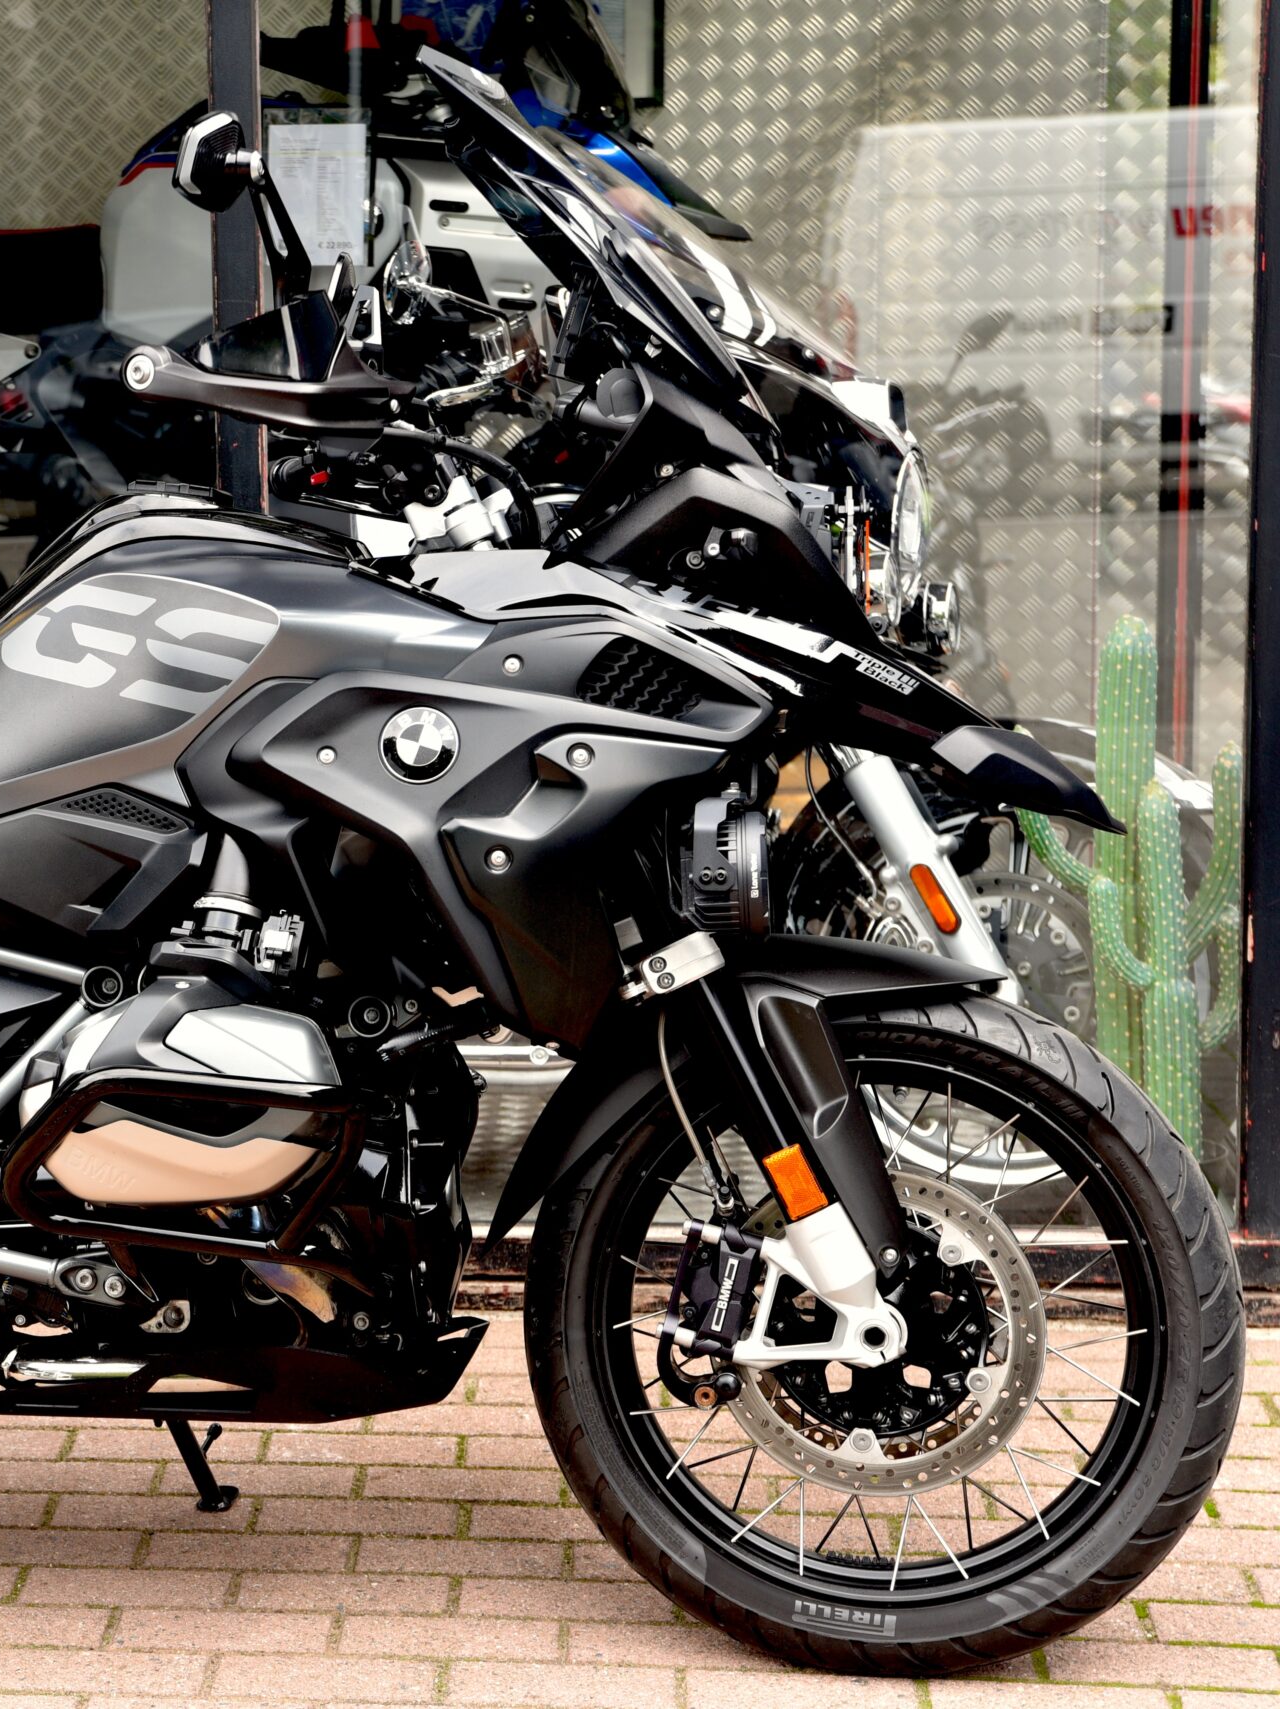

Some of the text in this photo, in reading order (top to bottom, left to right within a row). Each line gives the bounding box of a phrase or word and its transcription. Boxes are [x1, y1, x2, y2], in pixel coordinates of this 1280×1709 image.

[1, 584, 280, 716] GS
[854, 650, 896, 676] Triple
[863, 666, 907, 692] Black
[396, 710, 455, 741] BMW
[717, 1277, 734, 1310] BMW
[792, 1599, 897, 1637] PIRELLI
